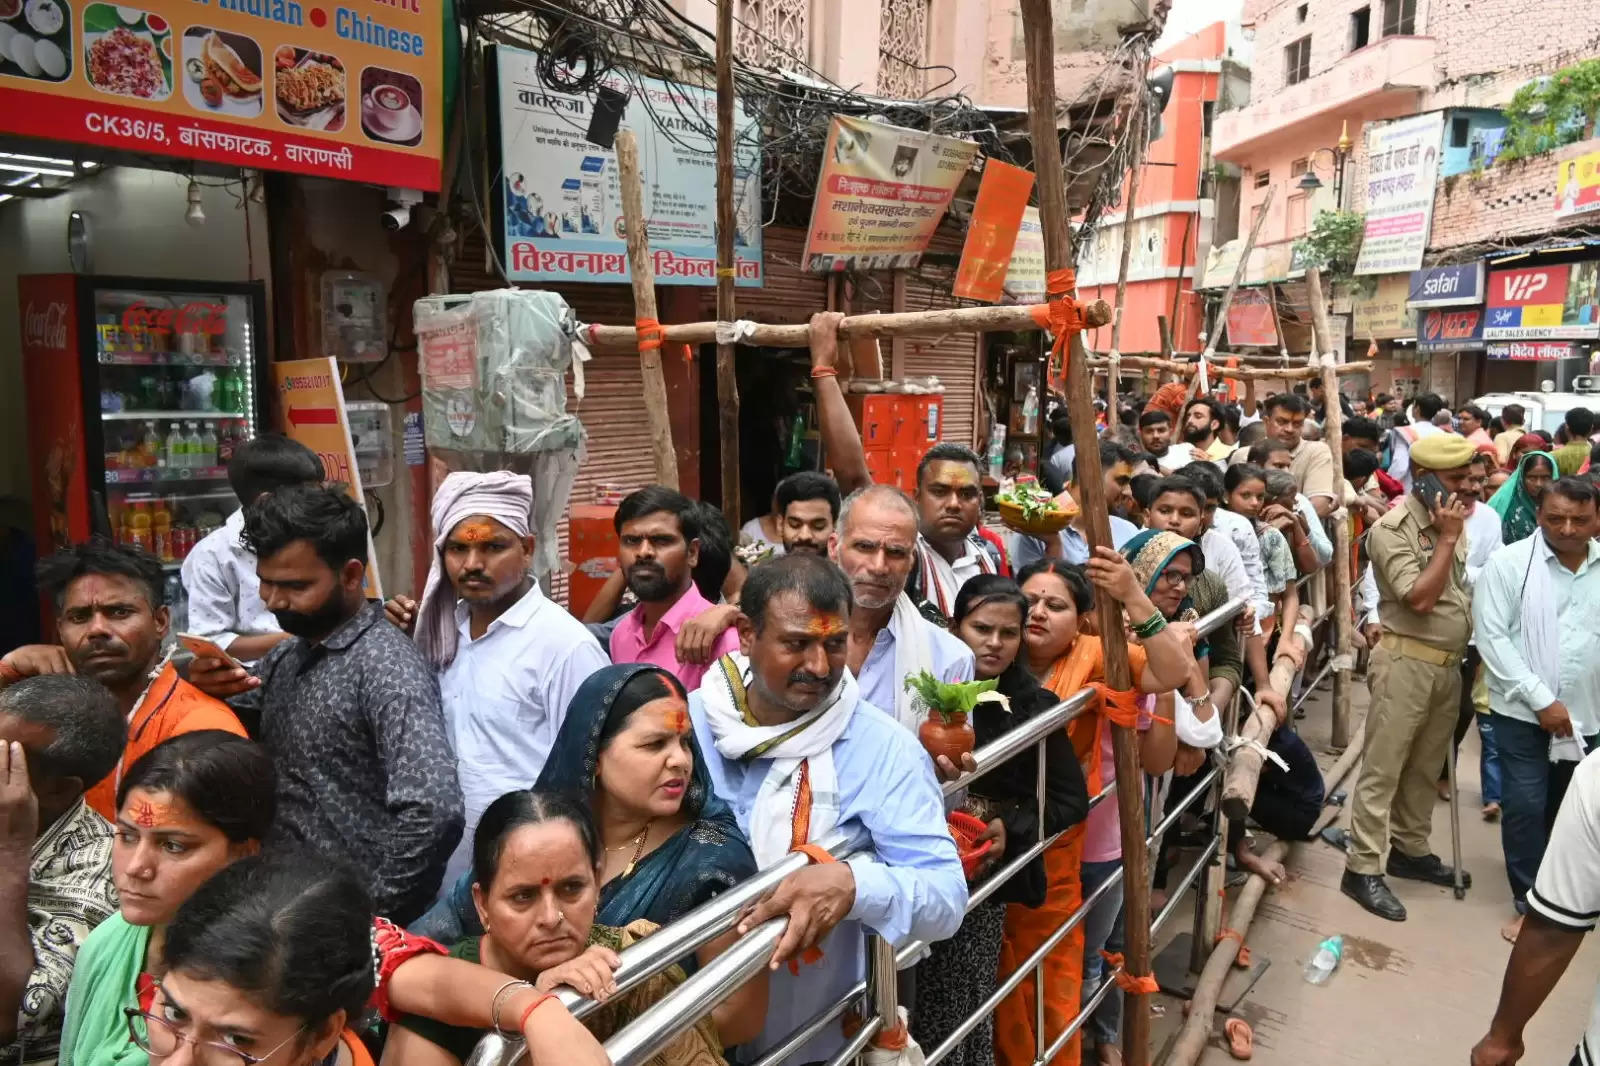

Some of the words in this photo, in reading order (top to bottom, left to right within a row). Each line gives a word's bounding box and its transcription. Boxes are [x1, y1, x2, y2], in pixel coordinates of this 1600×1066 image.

[335, 7, 425, 56] Chinese
[85, 112, 171, 146] CK36/5,
[285, 142, 353, 170] वाराणसी
[511, 242, 626, 276] विश्वनाथ
[650, 249, 715, 278] डिकल
[1423, 271, 1460, 295] safari
[1486, 328, 1504, 338] LALIT
[1504, 328, 1525, 338] SALES
[1525, 327, 1552, 338] AGENCY
